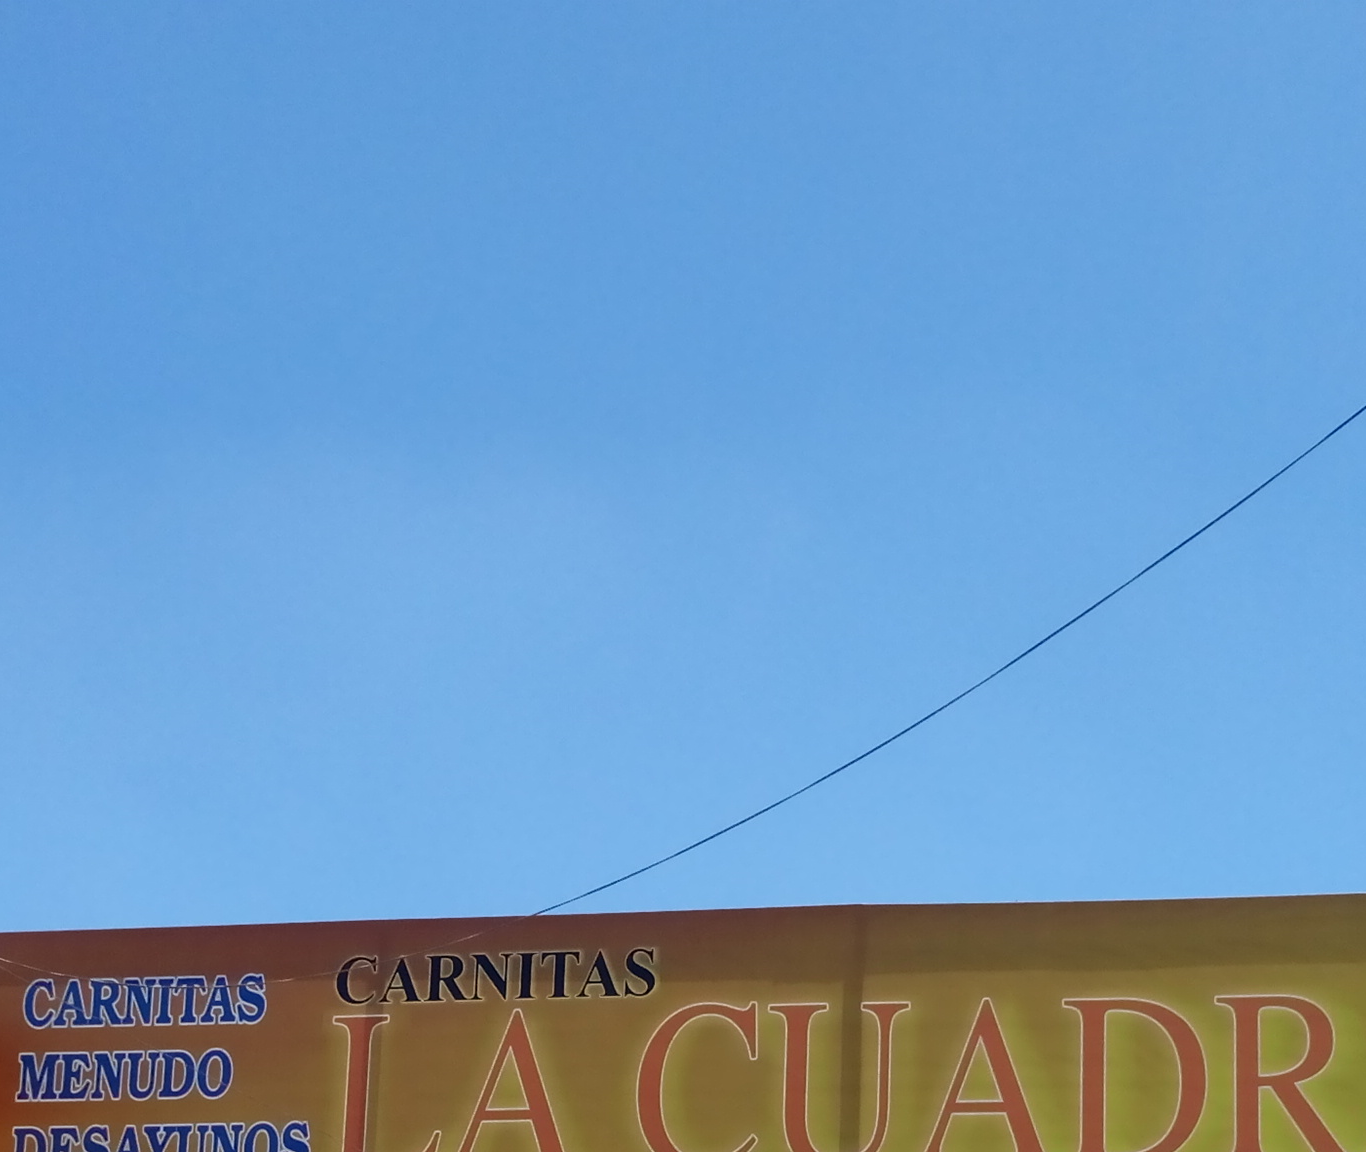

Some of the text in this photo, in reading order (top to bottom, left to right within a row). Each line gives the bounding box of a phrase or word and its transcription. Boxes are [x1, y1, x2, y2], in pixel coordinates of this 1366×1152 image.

[23, 973, 268, 1030] CARNITAS
[335, 947, 657, 1005] CARNITAS
[15, 1047, 234, 1103] MENUDO
